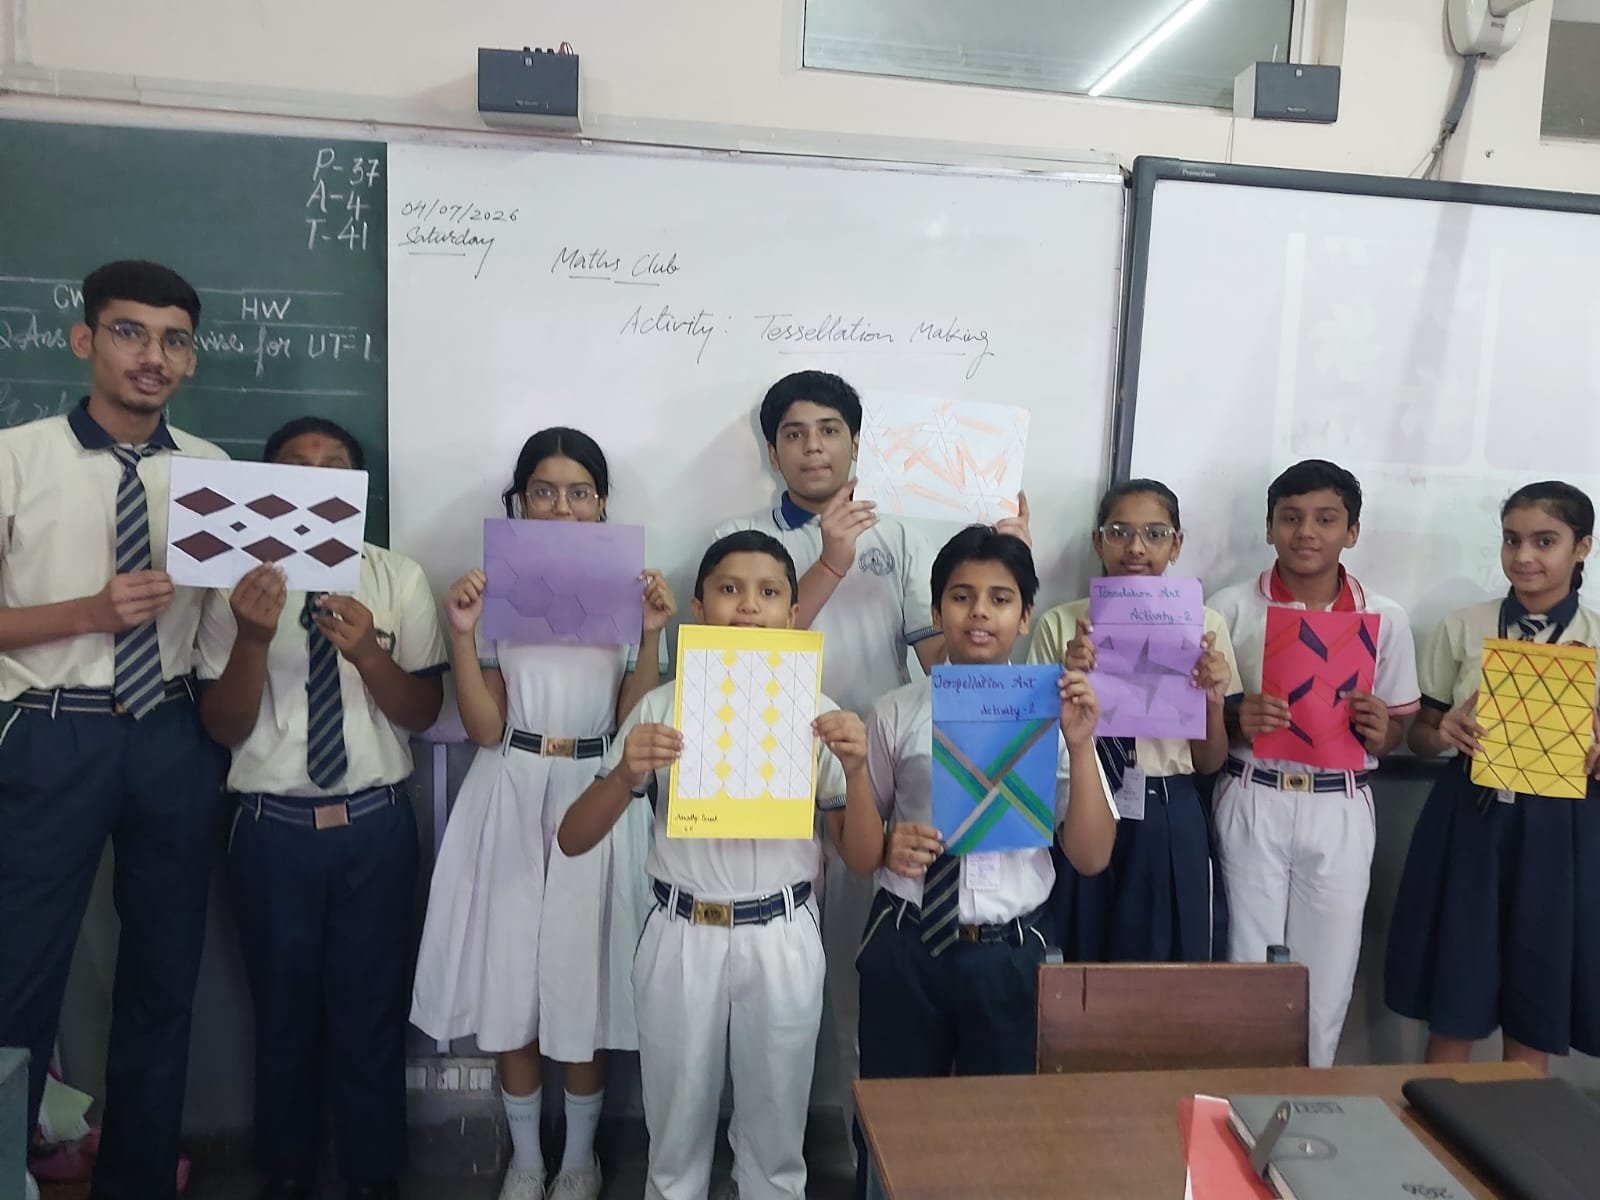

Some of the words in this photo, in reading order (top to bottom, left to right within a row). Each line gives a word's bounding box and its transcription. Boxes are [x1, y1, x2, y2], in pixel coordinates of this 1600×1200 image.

[400, 198, 520, 224] 04/07/2026
[398, 226, 496, 280] Saturday
[550, 247, 621, 274] Maths
[631, 252, 682, 278] Club
[241, 297, 292, 321] HW
[255, 326, 291, 377] for
[753, 313, 896, 344] Tessellation
[909, 315, 995, 381] Making
